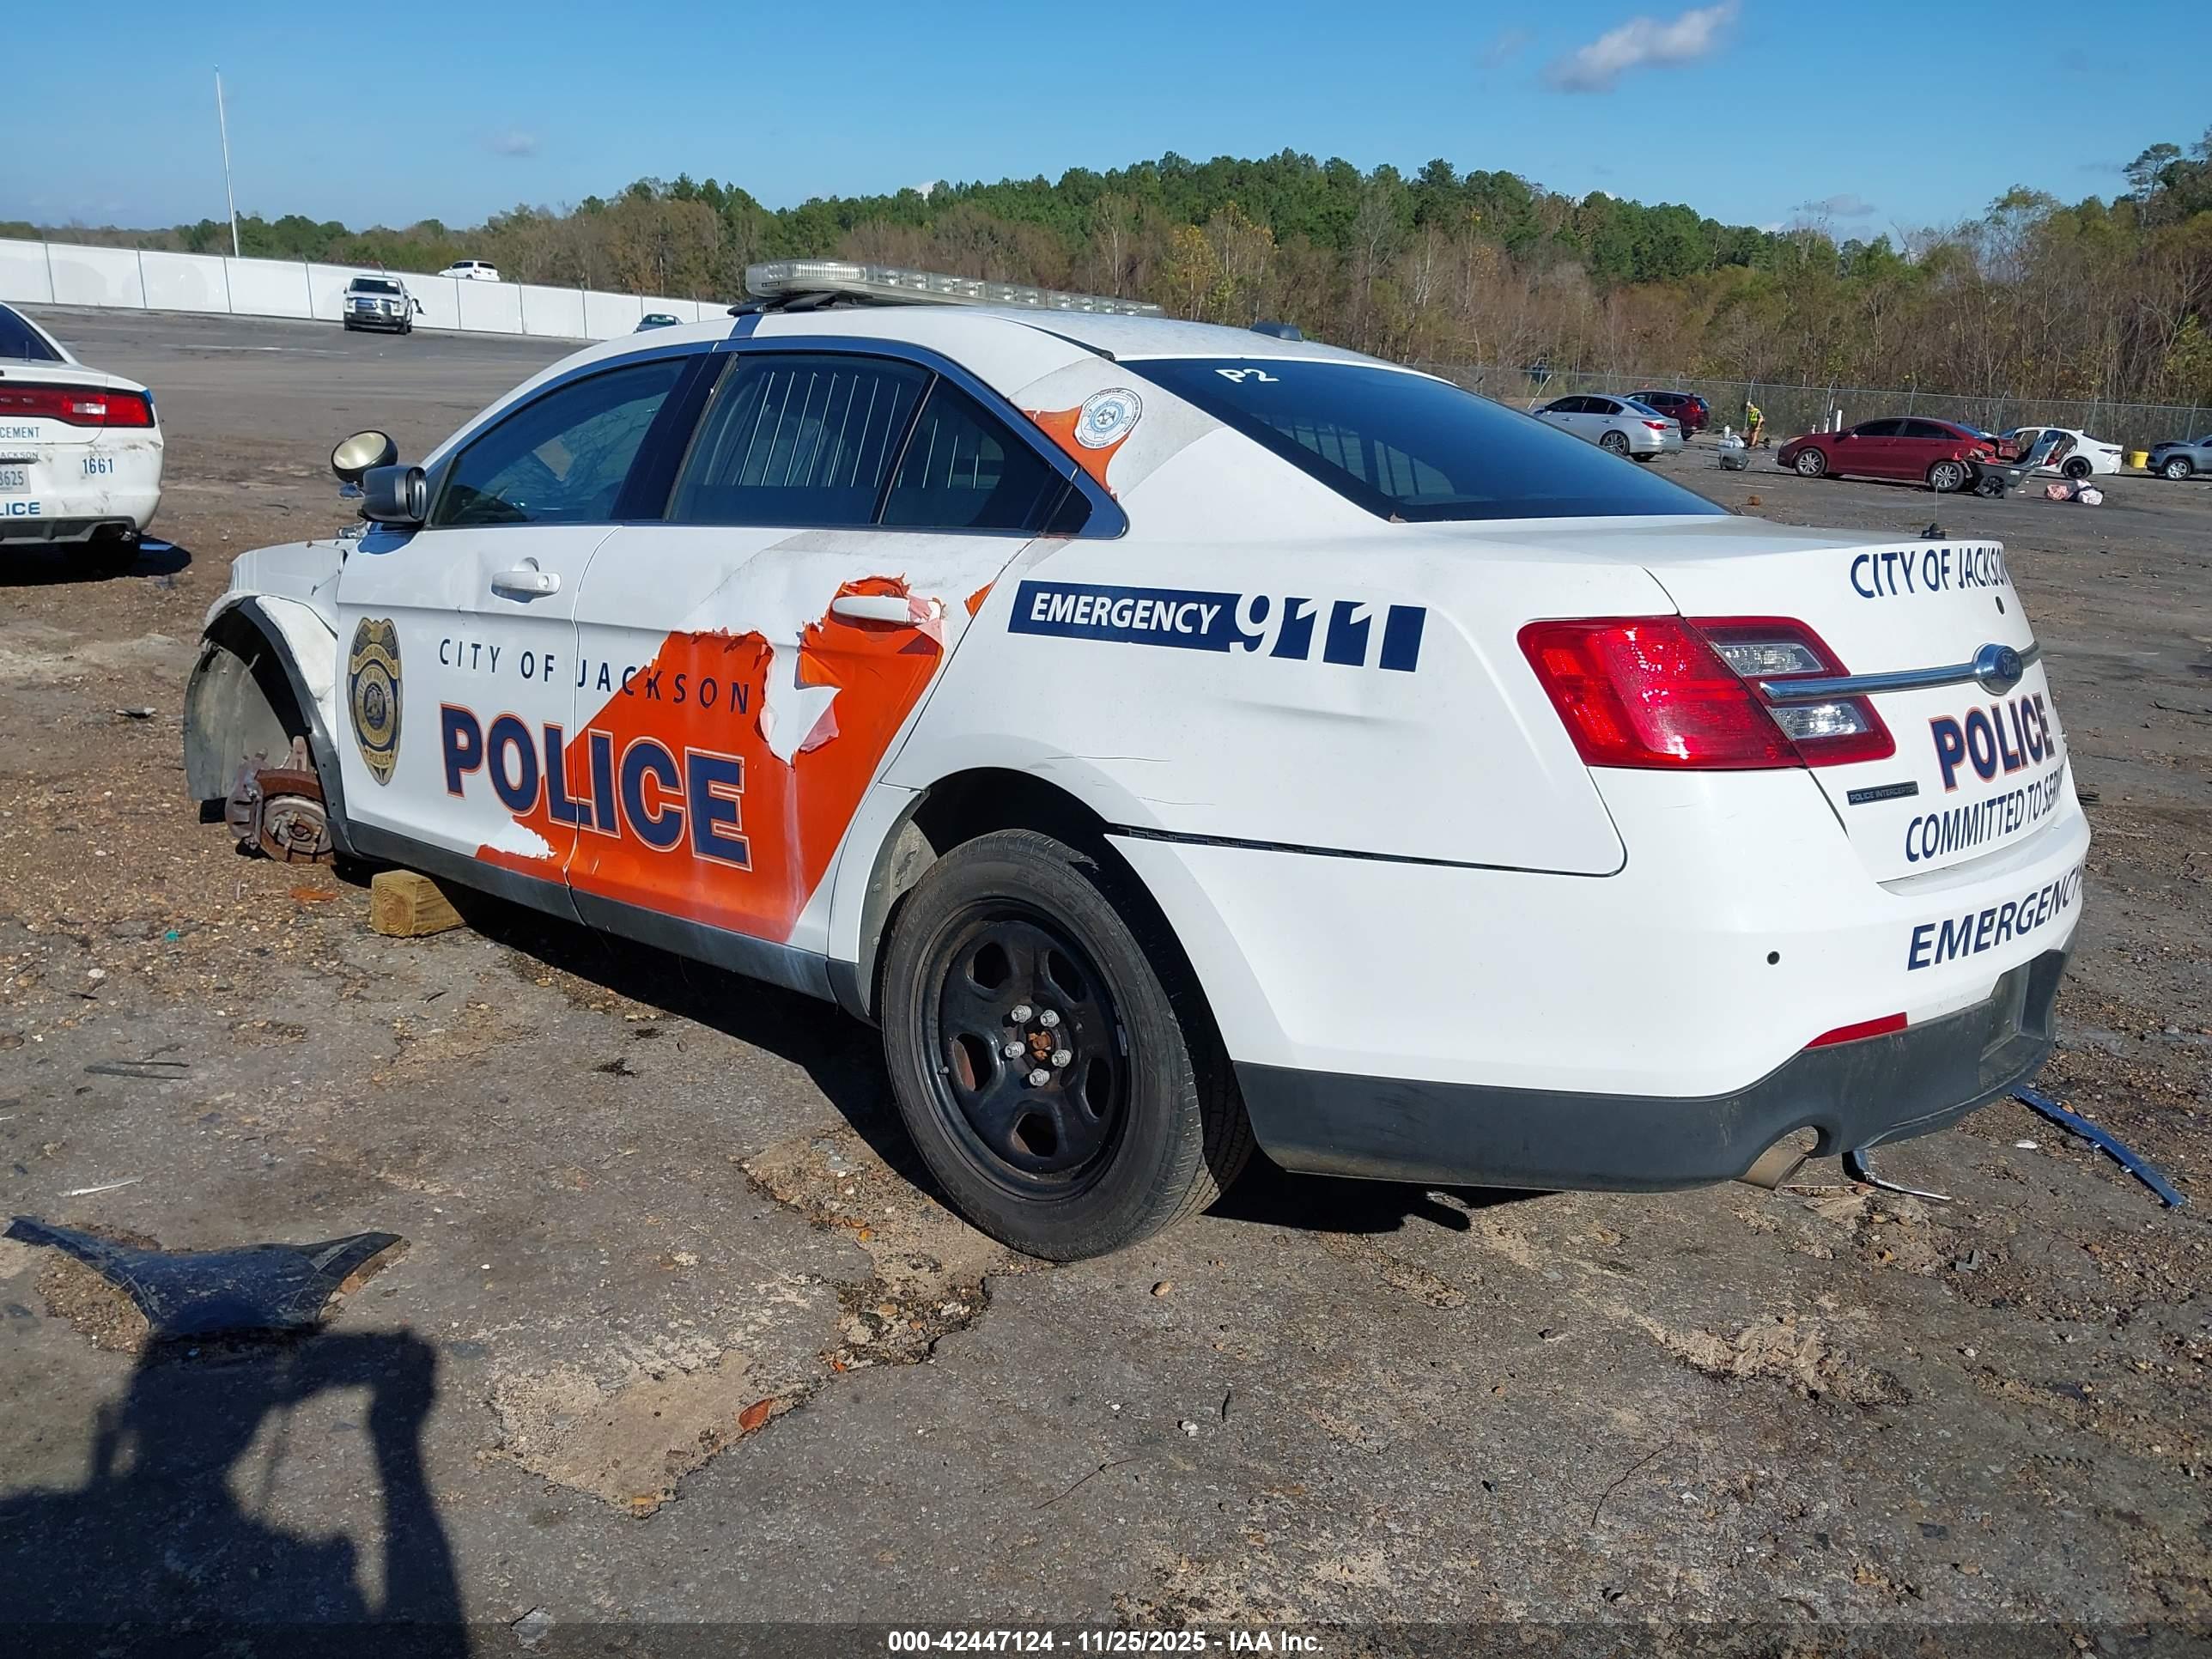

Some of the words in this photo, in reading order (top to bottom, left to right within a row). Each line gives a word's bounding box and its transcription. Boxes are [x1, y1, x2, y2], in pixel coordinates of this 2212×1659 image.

[1213, 368, 1280, 383] P2
[82, 458, 113, 474] 1661
[1850, 550, 1916, 599] CITY
[1923, 549, 1951, 592] OF
[1030, 592, 1222, 635] EMERGENCY
[1230, 592, 1391, 668] 911
[439, 638, 501, 674] CITY
[520, 651, 555, 683] OF
[577, 659, 750, 714] JACKSON
[1928, 691, 2057, 794] POLICE
[440, 701, 752, 872] POLICE
[1850, 791, 1875, 803] POLICE
[1905, 788, 2025, 863] COMMITTED
[2027, 781, 2042, 824] TO
